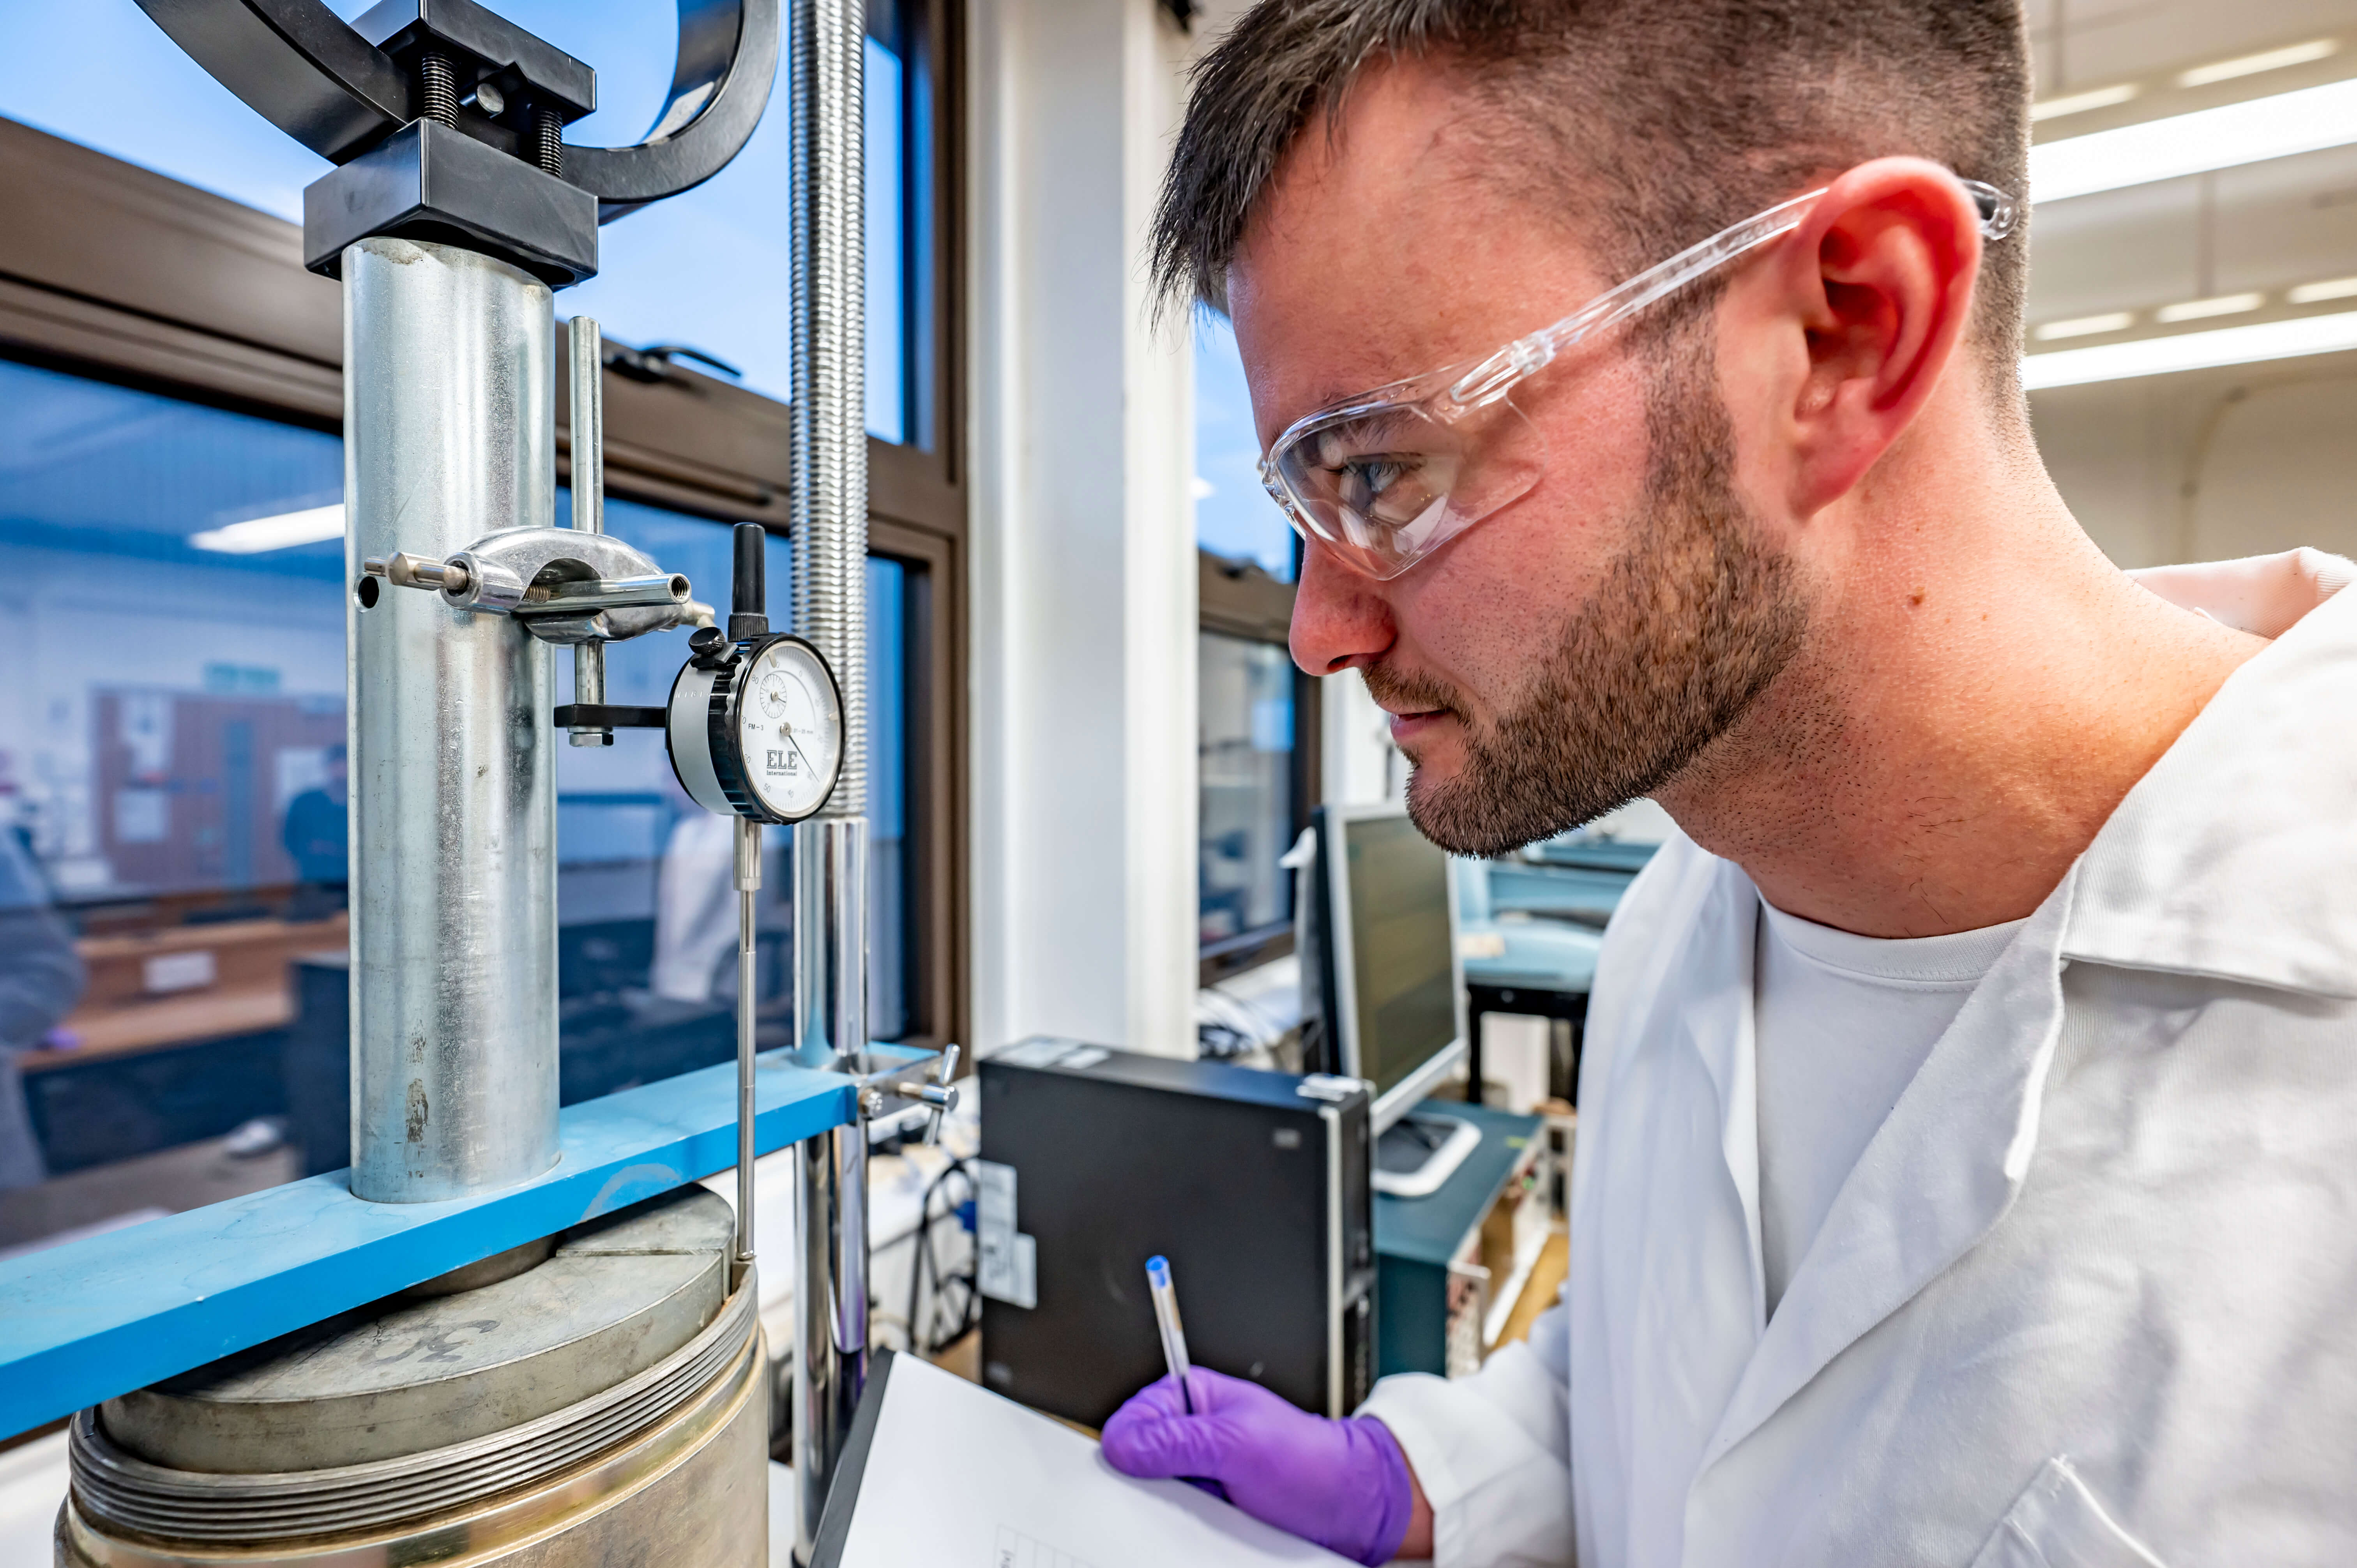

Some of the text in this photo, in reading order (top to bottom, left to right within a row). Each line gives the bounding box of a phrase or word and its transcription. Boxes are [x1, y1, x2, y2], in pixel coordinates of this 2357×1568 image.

[751, 674, 759, 685] 80
[767, 749, 797, 770] ELE
[763, 783, 771, 793] 50
[787, 789, 794, 798] 40
